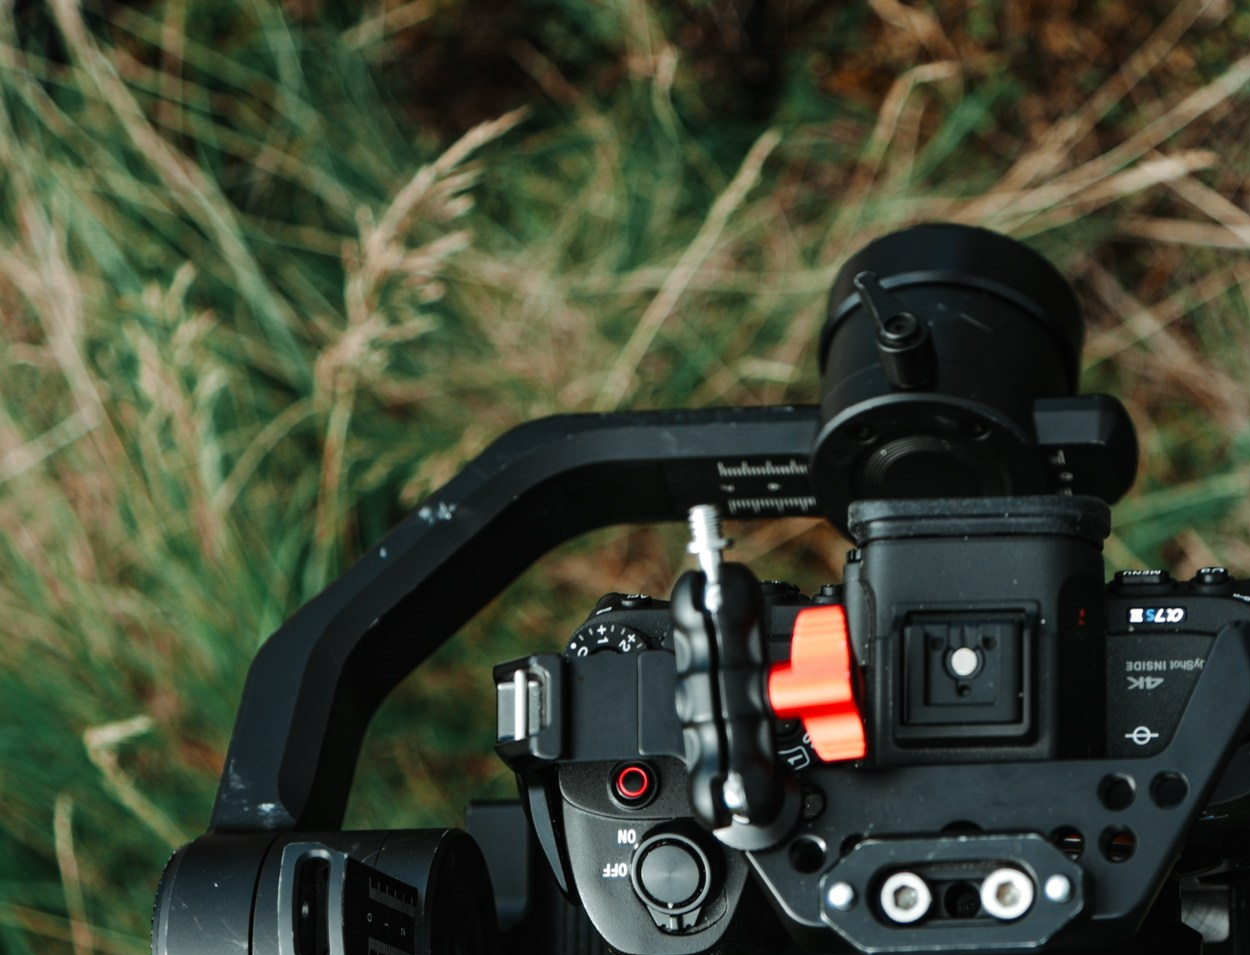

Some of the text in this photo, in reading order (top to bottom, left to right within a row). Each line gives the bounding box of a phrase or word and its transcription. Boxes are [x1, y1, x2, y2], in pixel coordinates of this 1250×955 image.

[1126, 660, 1167, 672] INSIDE
[1126, 676, 1164, 690] 4K
[617, 829, 637, 844] ON
[602, 862, 628, 878] OFF
